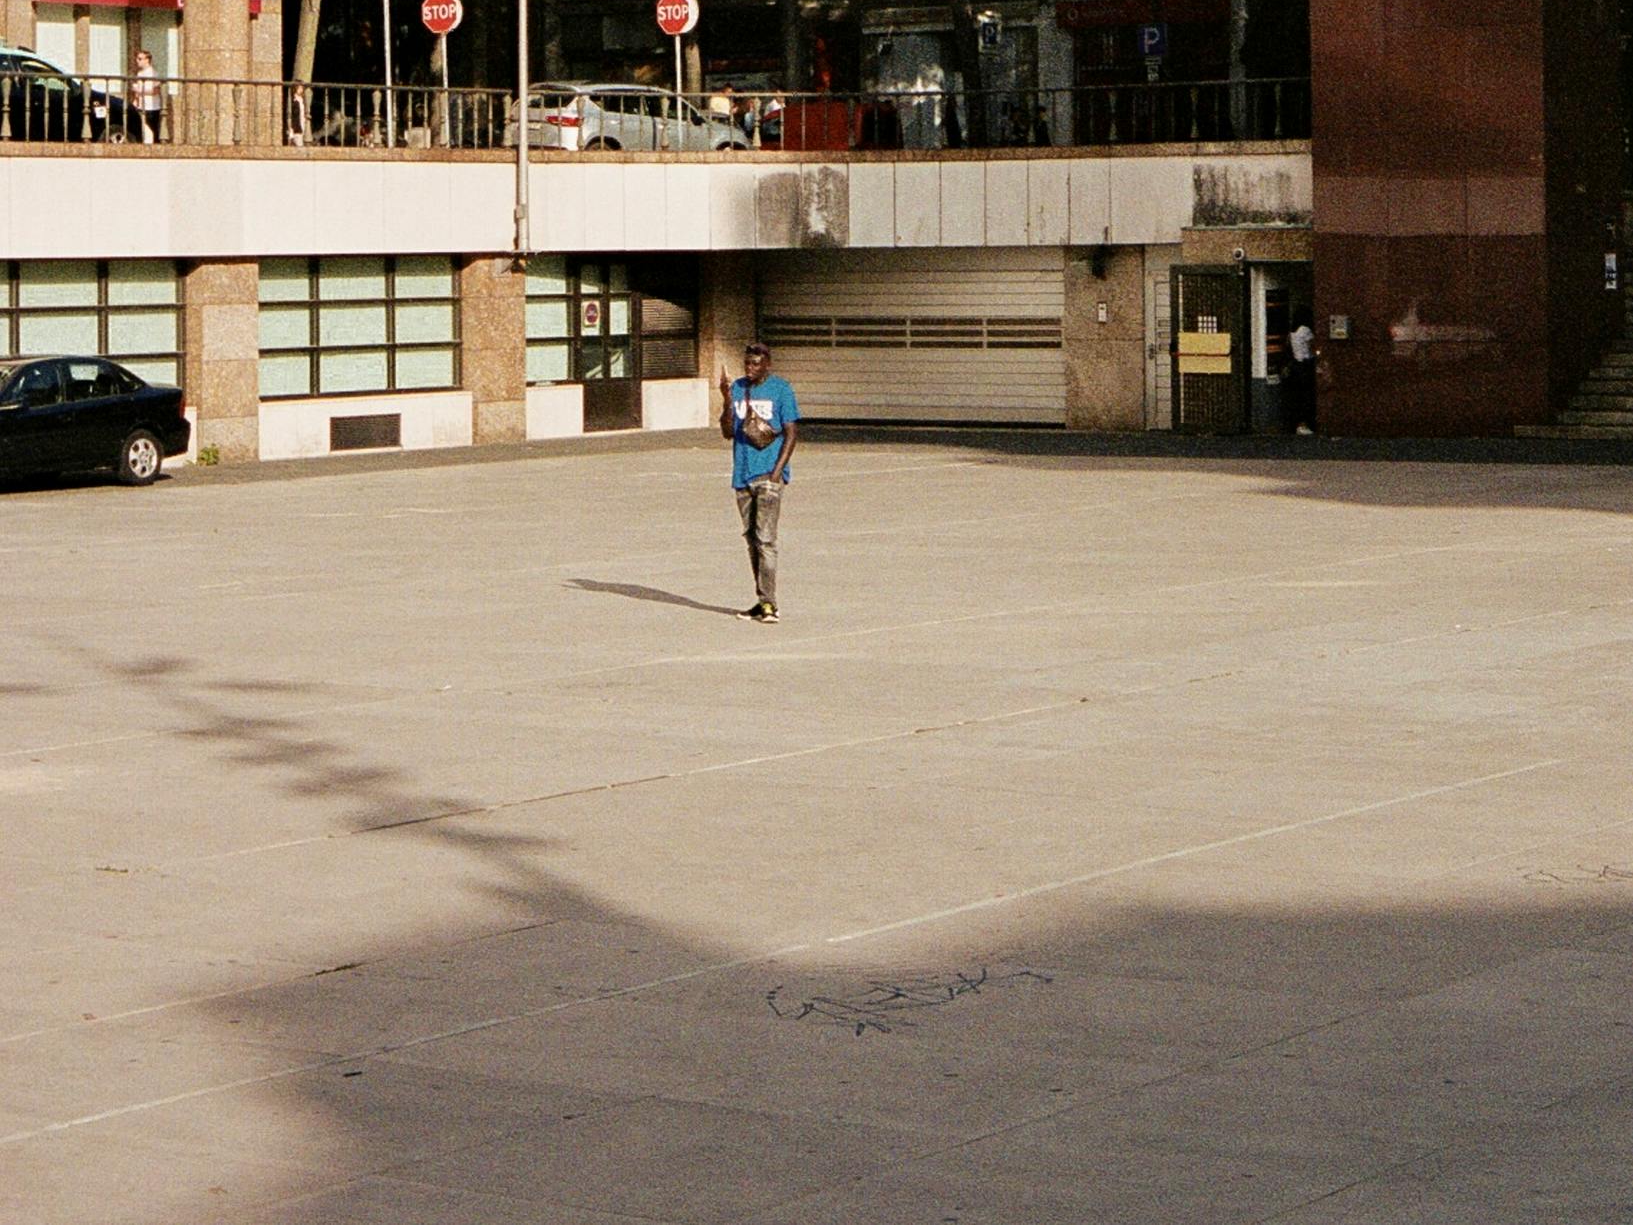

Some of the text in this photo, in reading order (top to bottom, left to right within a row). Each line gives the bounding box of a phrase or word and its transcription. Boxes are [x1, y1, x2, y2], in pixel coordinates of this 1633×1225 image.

[423, 3, 457, 21] STOP
[656, 3, 689, 21] STOP
[1143, 28, 1160, 53] P
